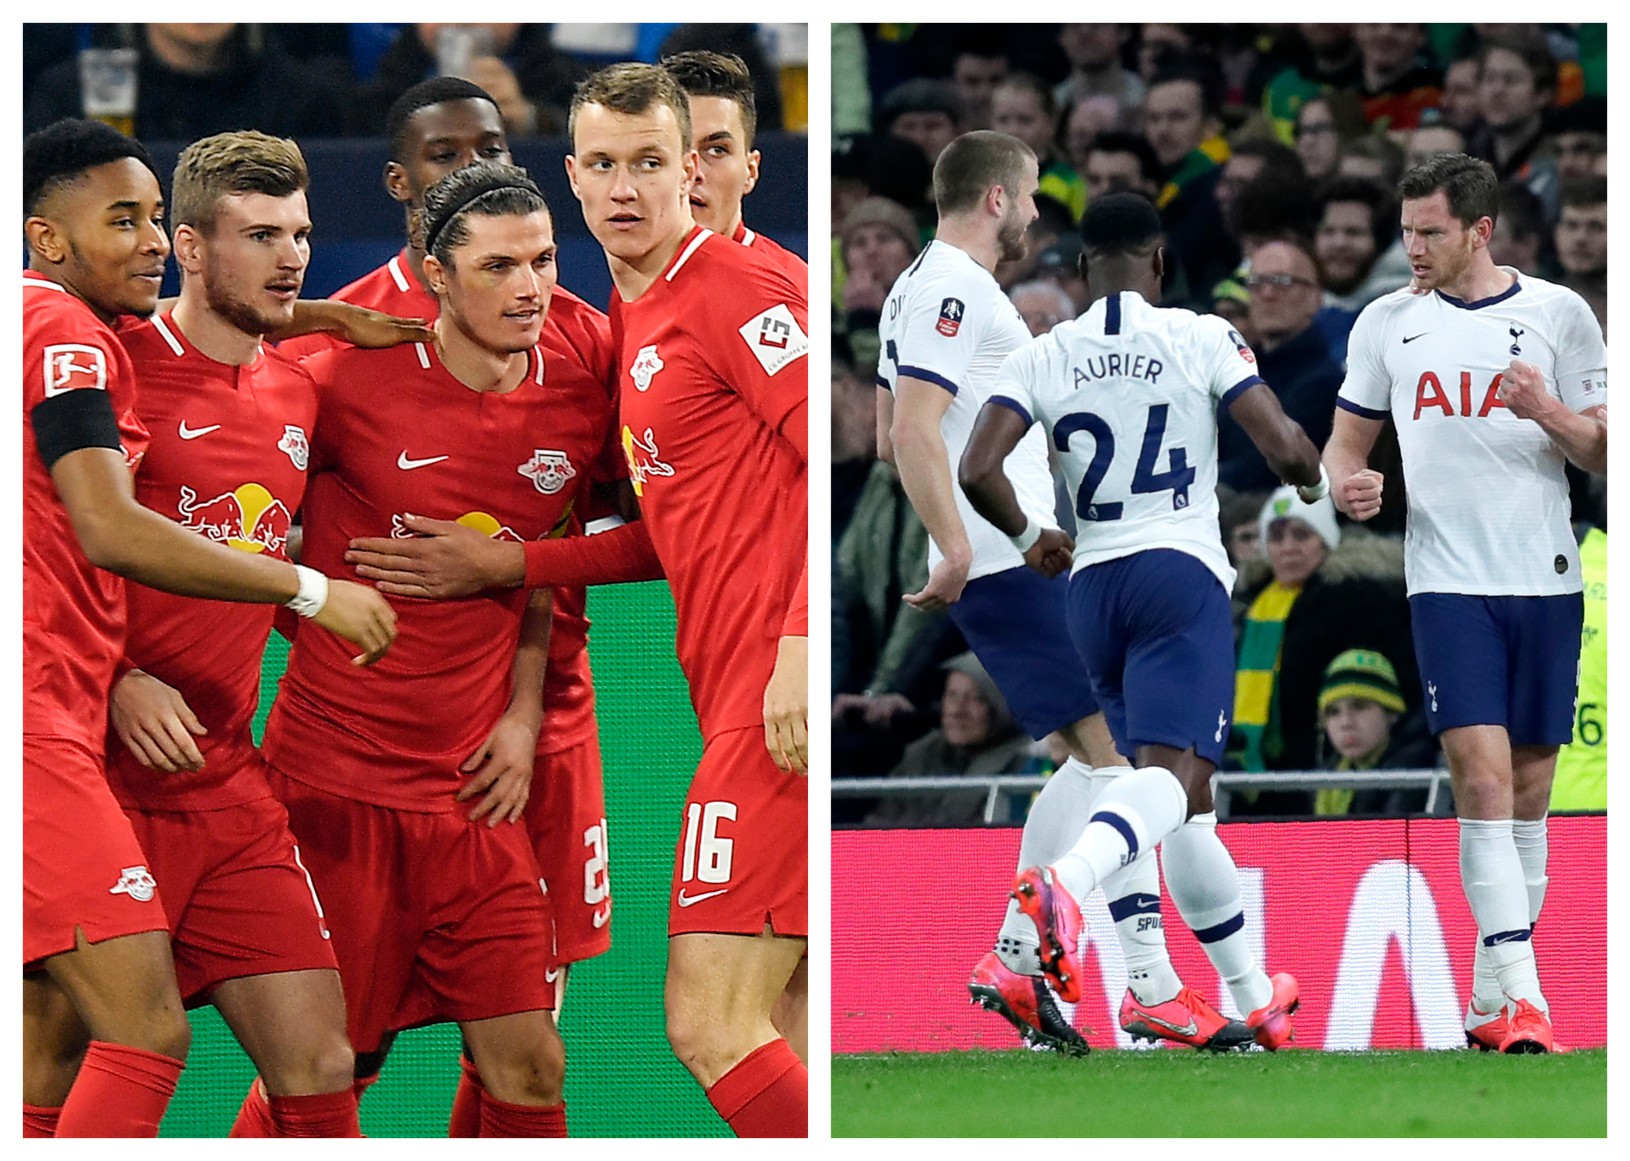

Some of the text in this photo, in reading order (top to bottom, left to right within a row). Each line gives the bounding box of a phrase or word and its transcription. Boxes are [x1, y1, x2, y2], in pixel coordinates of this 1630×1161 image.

[889, 294, 906, 321] DI
[1073, 353, 1163, 390] AURIER
[1053, 403, 1196, 522] 24
[682, 801, 737, 883] 16
